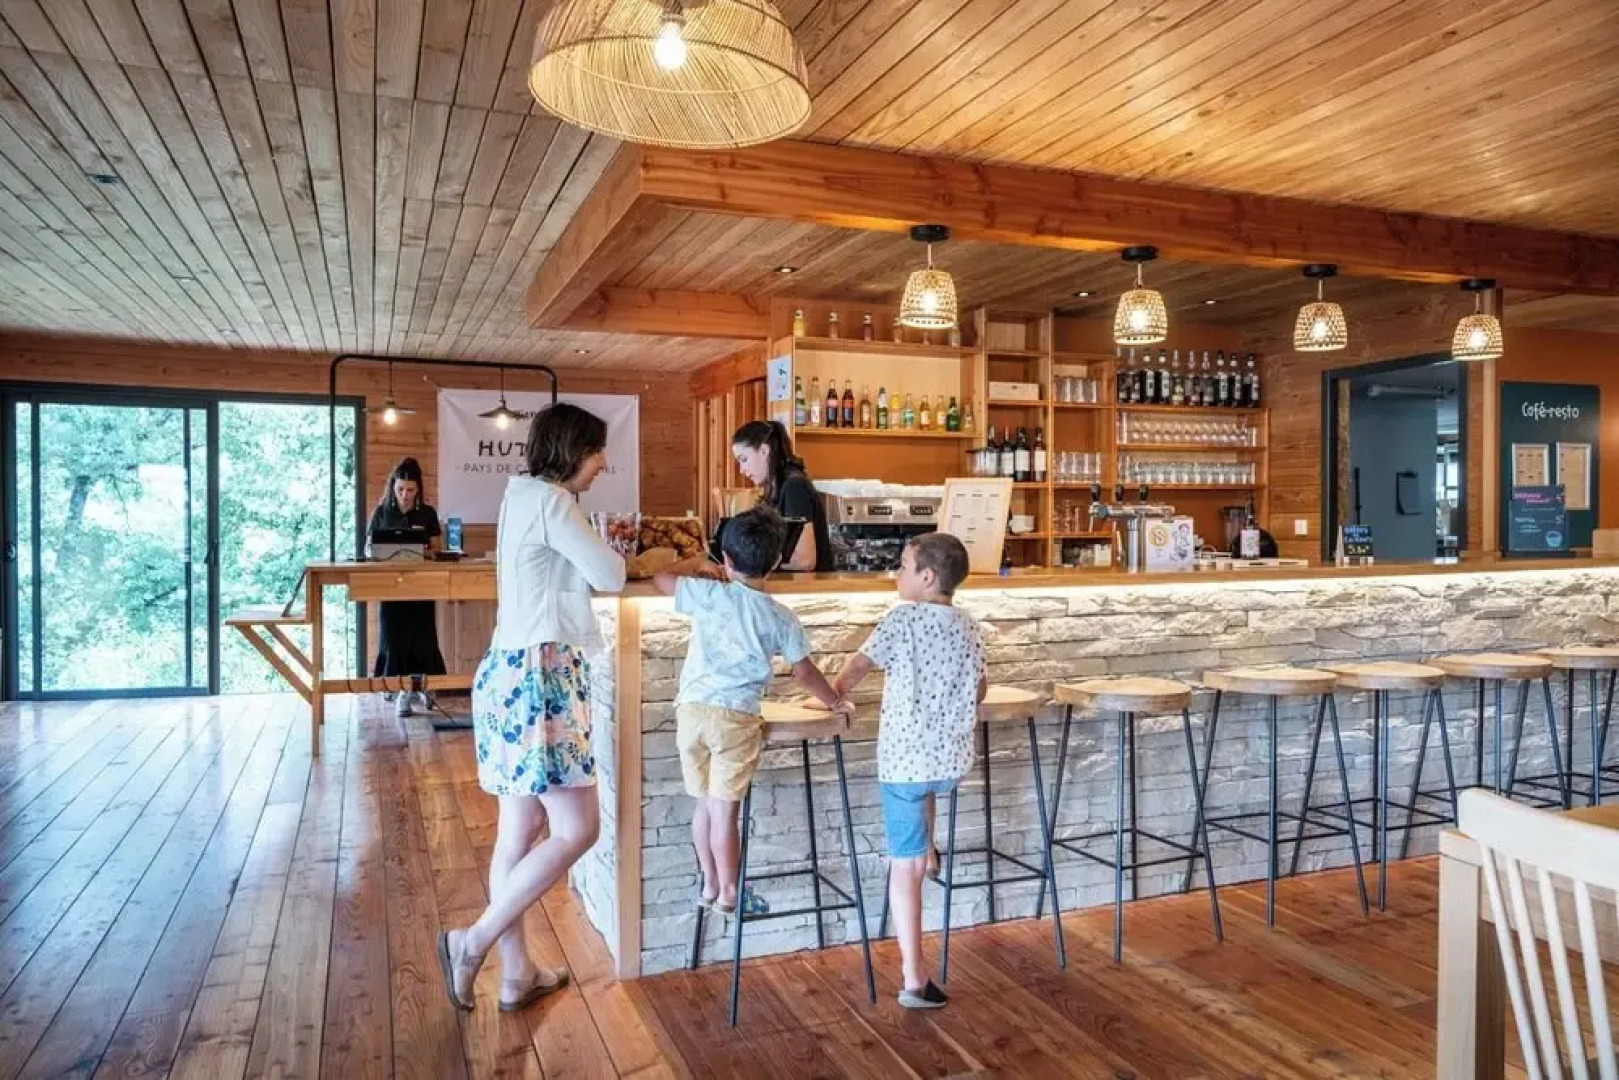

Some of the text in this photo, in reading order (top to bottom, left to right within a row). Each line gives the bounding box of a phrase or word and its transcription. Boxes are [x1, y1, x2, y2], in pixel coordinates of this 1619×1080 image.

[1521, 401, 1580, 421] Café-resto
[478, 440, 527, 457] HUT
[464, 463, 492, 474] PAYS
[496, 464, 511, 474] DE
